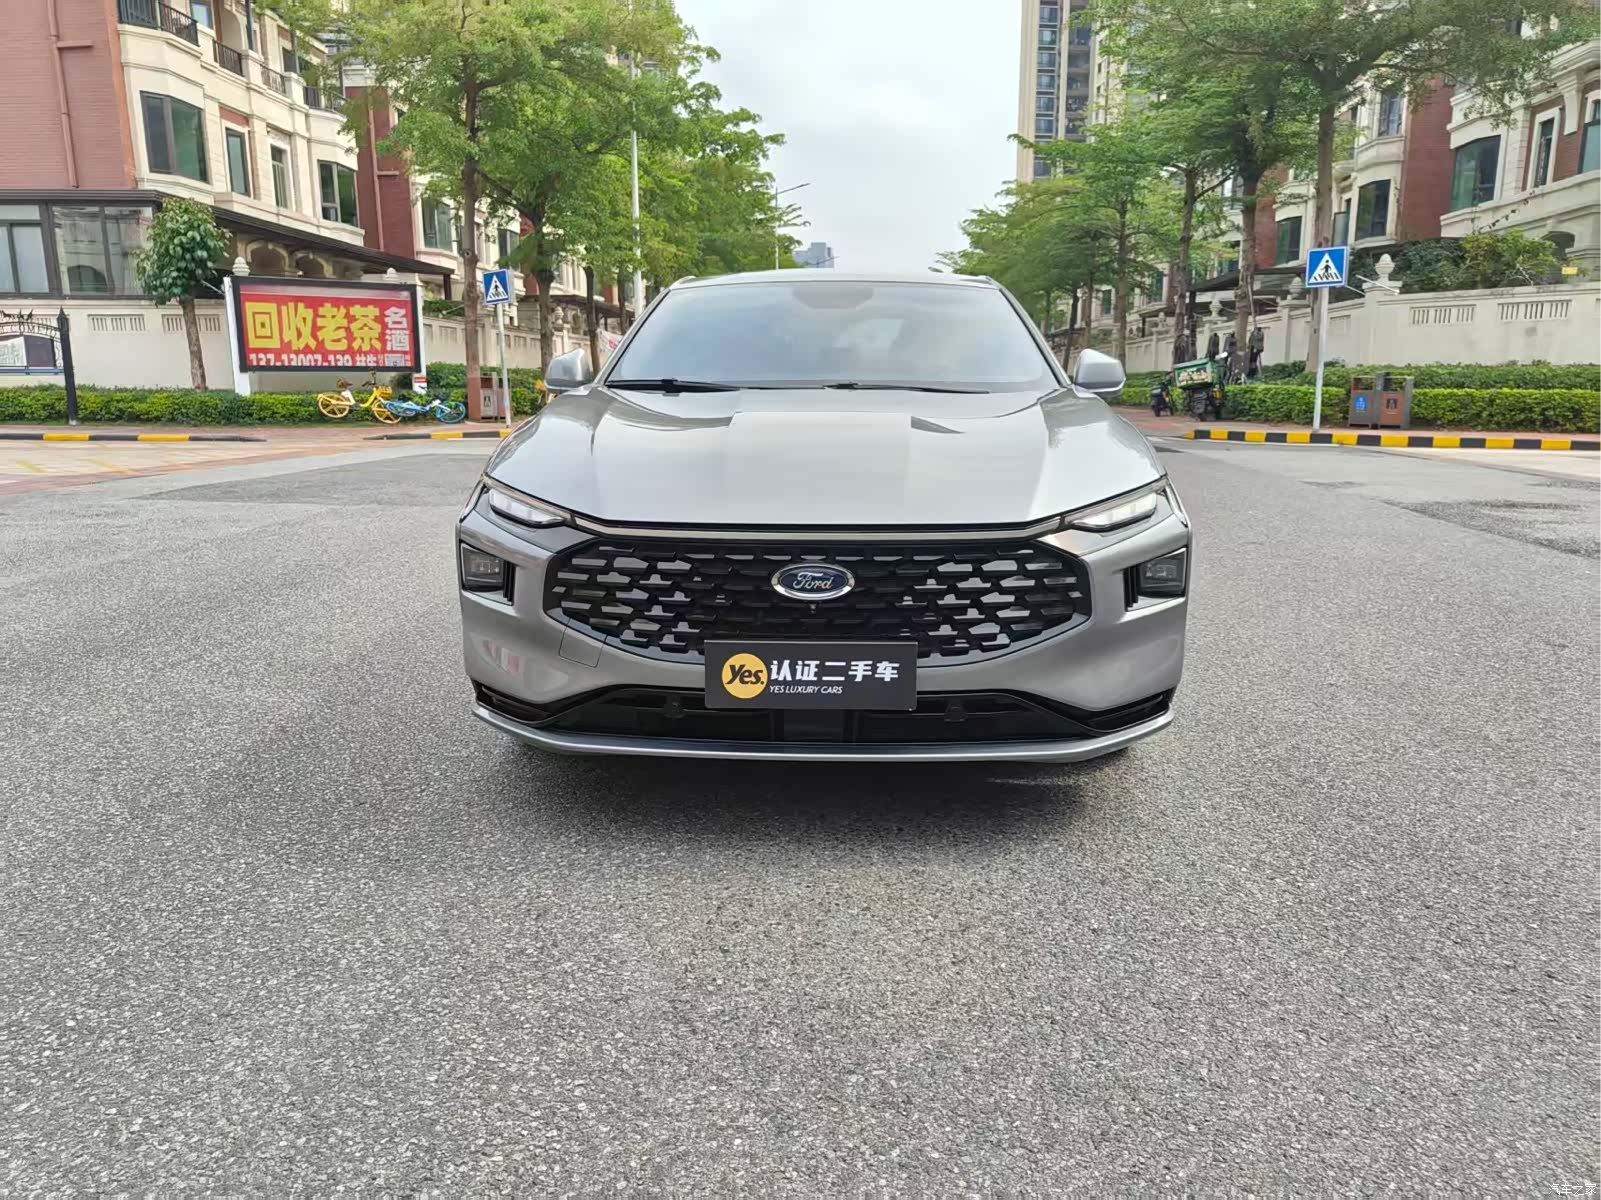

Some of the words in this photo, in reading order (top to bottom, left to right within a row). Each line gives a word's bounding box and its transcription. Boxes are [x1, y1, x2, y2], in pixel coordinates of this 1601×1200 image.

[245, 301, 382, 351] 回收老茶
[384, 306, 410, 351] 名酒
[792, 571, 834, 590] Ford
[770, 659, 899, 682] 认证二手车
[770, 685, 785, 694] YES
[786, 685, 820, 694] LUXURY
[821, 685, 843, 694] CARS
